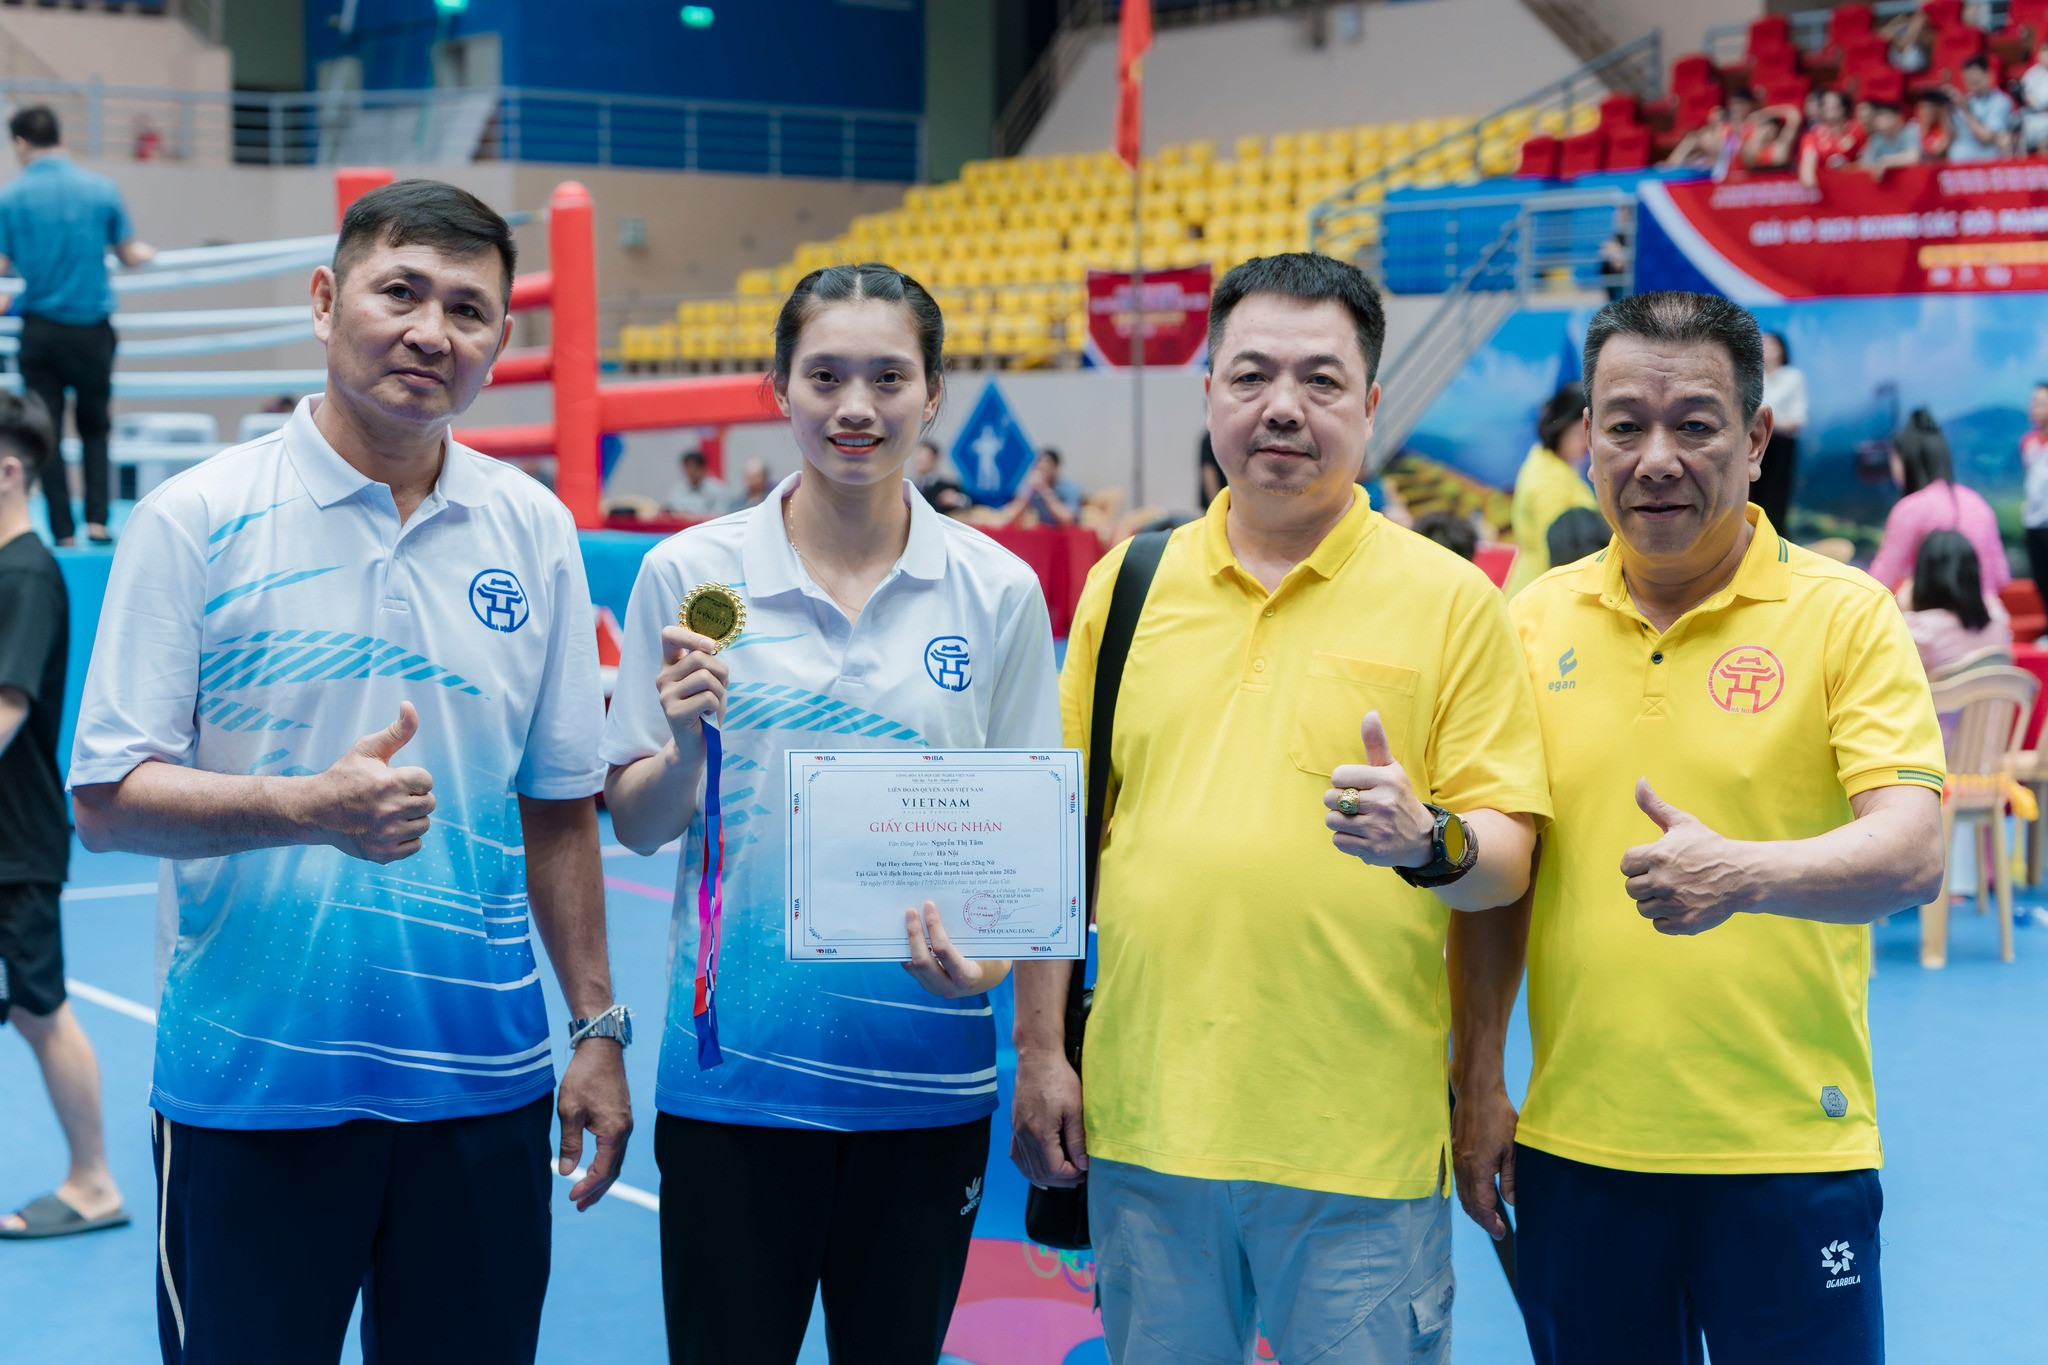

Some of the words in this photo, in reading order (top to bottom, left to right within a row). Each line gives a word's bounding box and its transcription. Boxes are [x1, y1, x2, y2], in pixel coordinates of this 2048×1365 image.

[1548, 679, 1576, 692] egan
[901, 798, 970, 807] VIETNAM
[869, 819, 902, 832] GIẤY
[905, 819, 957, 832] CHỨNG
[961, 819, 1002, 834] NHẬN
[1825, 1275, 1861, 1289] OGARBOLA
